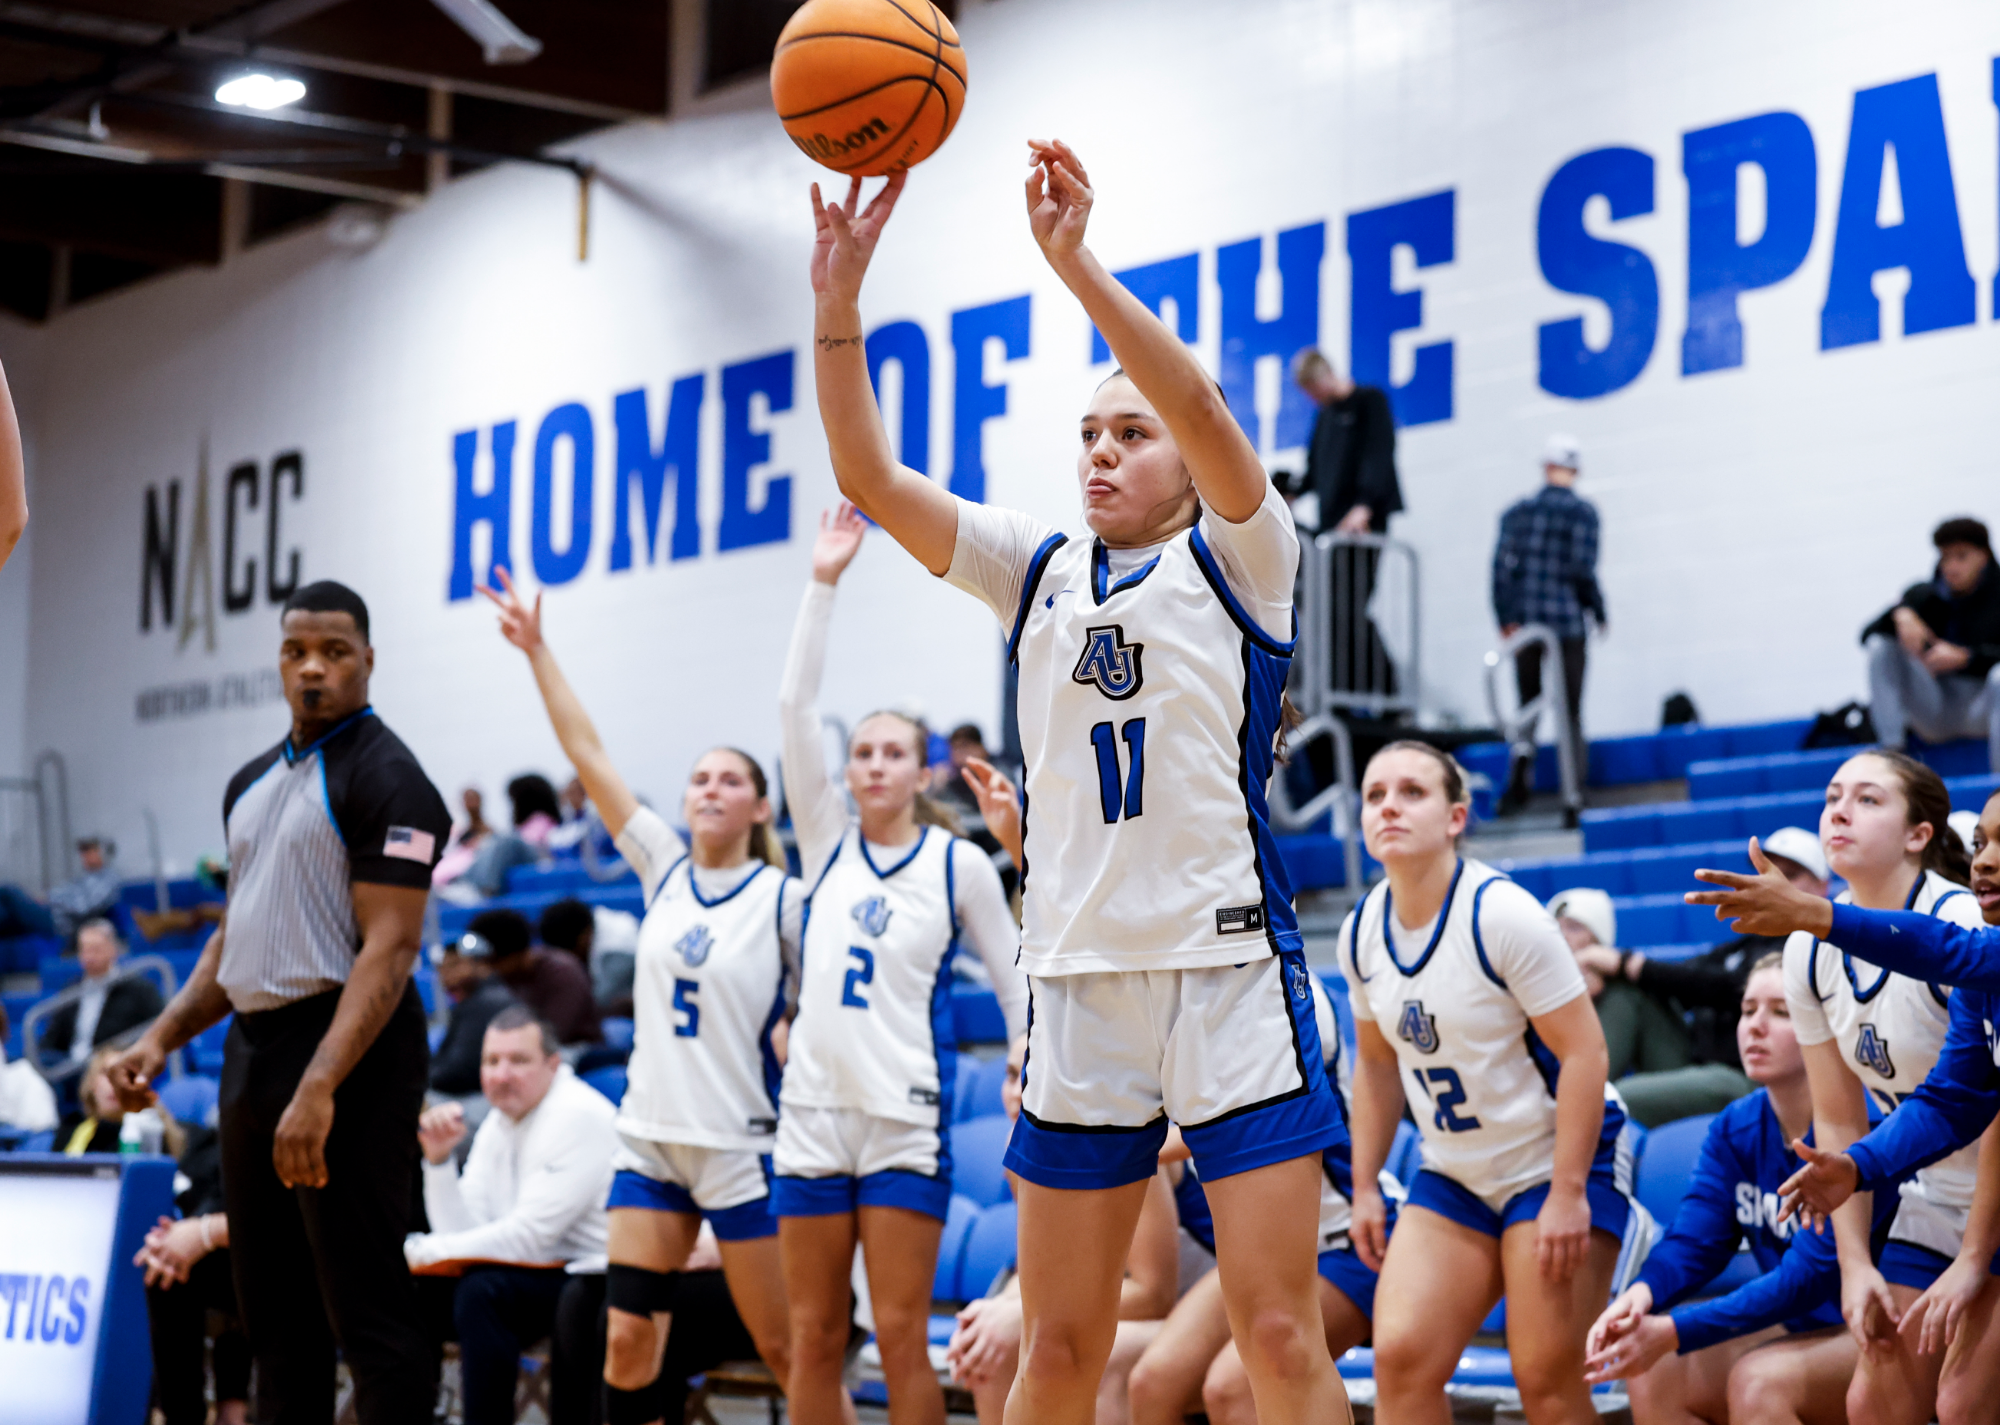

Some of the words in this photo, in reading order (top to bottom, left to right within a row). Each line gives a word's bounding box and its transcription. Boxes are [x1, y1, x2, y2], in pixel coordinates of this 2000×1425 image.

[448, 348, 796, 604] HOME
[1536, 55, 2000, 400] SPA
[138, 433, 304, 652] NACC
[1073, 624, 1144, 701] AU
[1090, 717, 1146, 825] 11
[1250, 912, 1258, 924] M
[671, 977, 700, 1038] 5
[841, 945, 875, 1009] 2
[1412, 1066, 1481, 1133] 12
[0, 1272, 90, 1345] TICS
